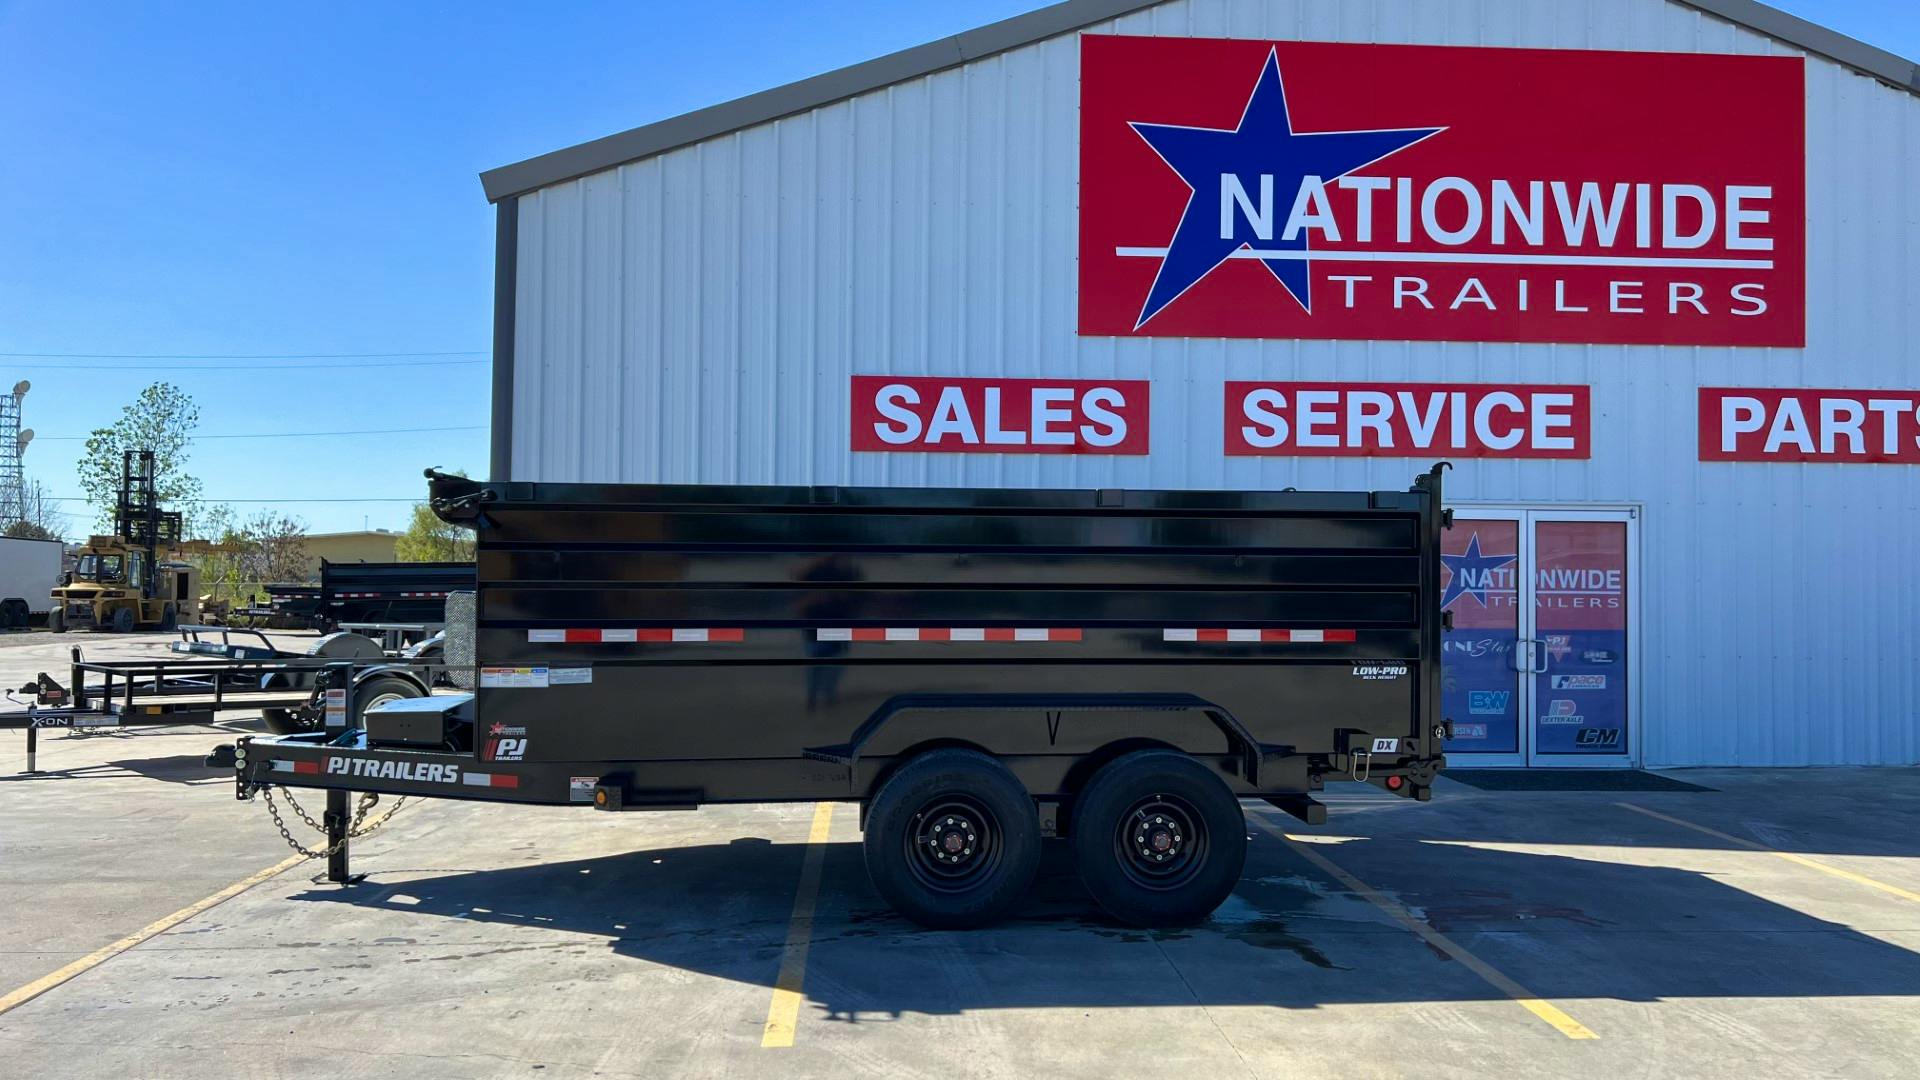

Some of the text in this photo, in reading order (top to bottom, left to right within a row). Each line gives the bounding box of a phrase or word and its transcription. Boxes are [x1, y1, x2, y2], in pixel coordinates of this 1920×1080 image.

[1220, 173, 1774, 251] NATIONWIDE
[1327, 275, 1767, 316] TRAILERS
[873, 384, 1127, 447] SALES
[1241, 388, 1575, 450] SERVICE
[1721, 396, 1920, 455] PART
[1460, 568, 1621, 589] NATINWIDE
[1352, 666, 1407, 675] LOW-PRO
[495, 738, 528, 755] PJ
[1376, 740, 1393, 751] DX
[327, 756, 459, 783] PJ TRAILERS
